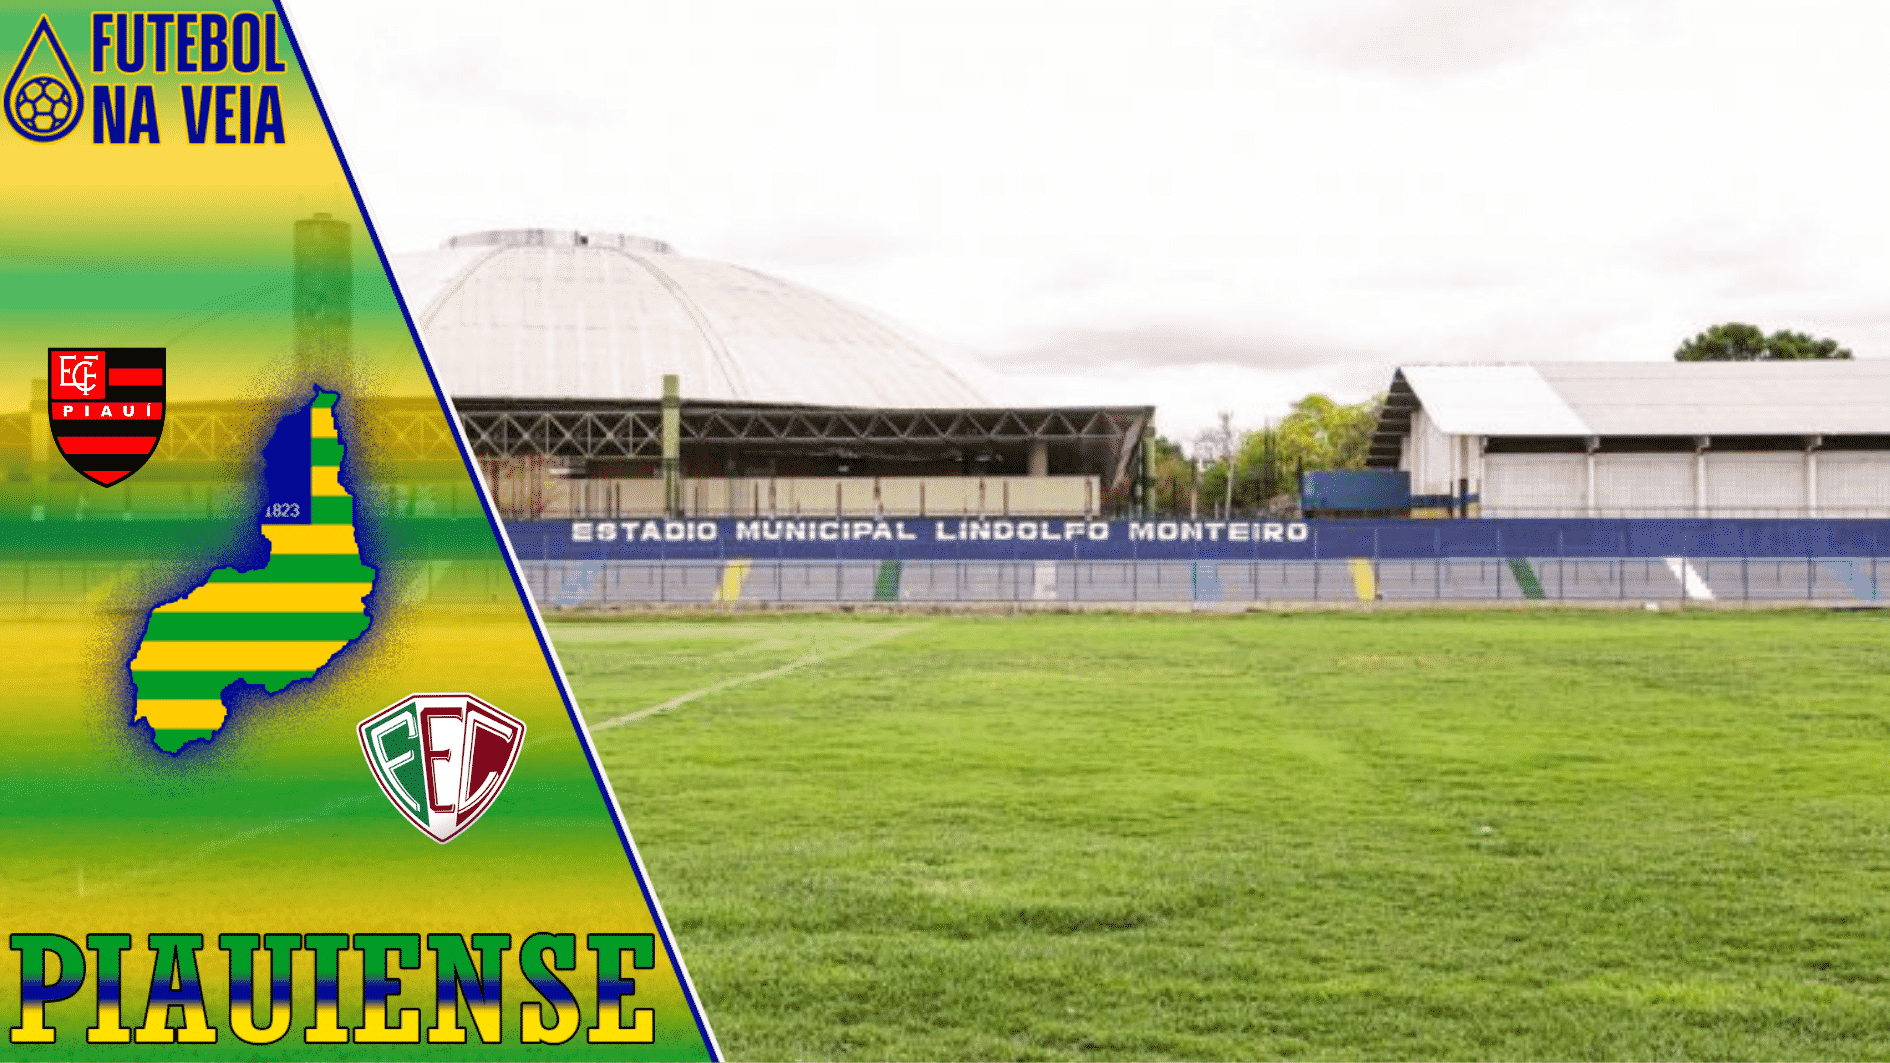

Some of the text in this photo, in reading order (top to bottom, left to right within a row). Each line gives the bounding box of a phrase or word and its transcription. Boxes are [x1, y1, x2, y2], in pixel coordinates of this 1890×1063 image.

[735, 521, 917, 541] MUNICIPAL
[935, 521, 1110, 541] LINDOLFO
[1128, 521, 1309, 542] MONTEIRO
